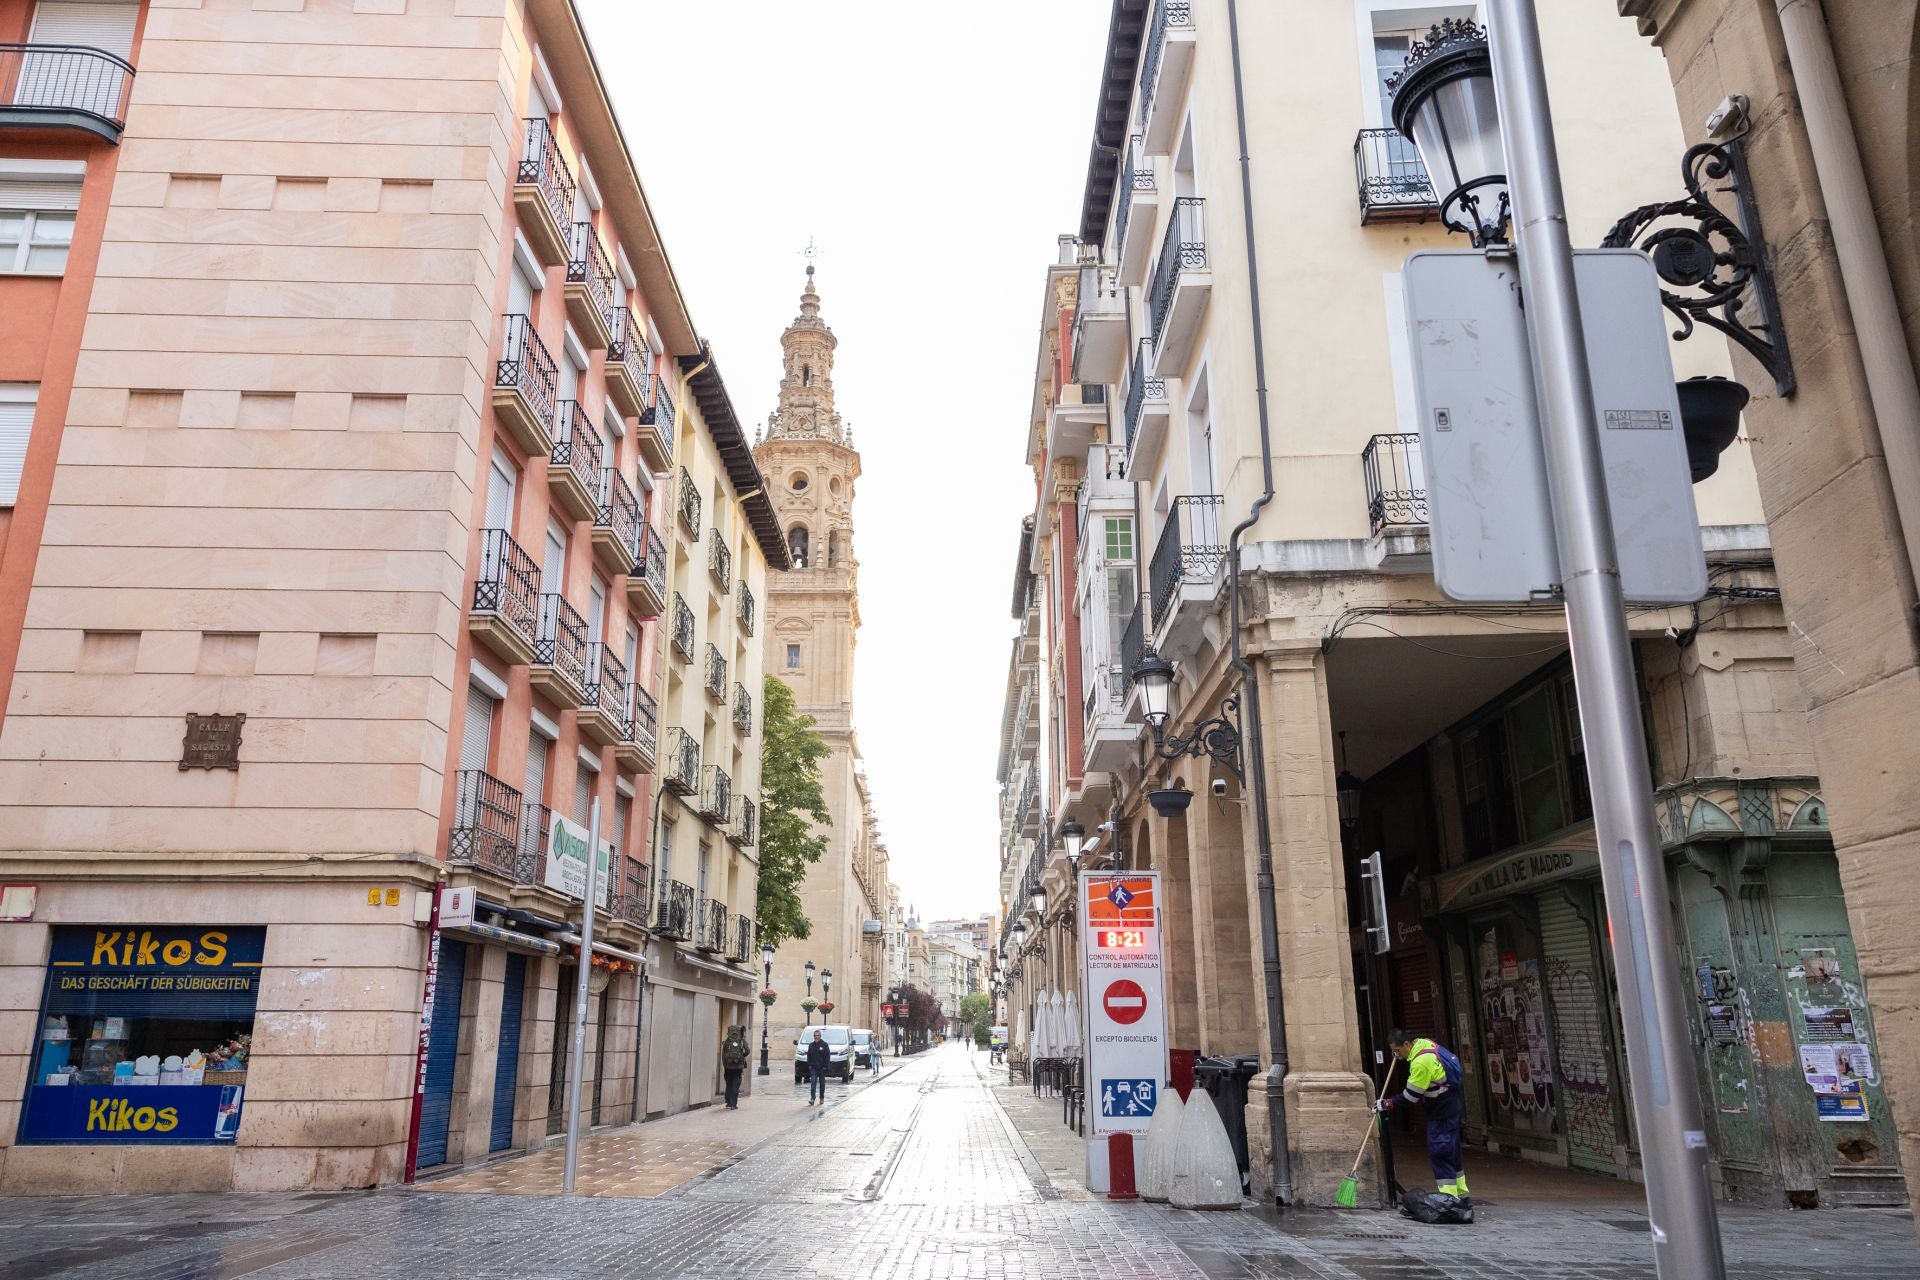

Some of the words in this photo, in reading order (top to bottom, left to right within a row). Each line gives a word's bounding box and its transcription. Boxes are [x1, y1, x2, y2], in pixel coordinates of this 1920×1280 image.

[1482, 865, 1510, 890] VILLA
[1511, 859, 1527, 882] DE
[1529, 853, 1574, 877] MADRID
[1107, 932, 1143, 947] 8:21
[1089, 953, 1117, 961] CONTROL
[61, 977, 85, 990] DAS
[88, 975, 148, 990] GESCHÄFT
[151, 977, 173, 990] DER
[1123, 1035, 1158, 1043] BICICLETAS
[86, 1098, 179, 1132] Kikos
